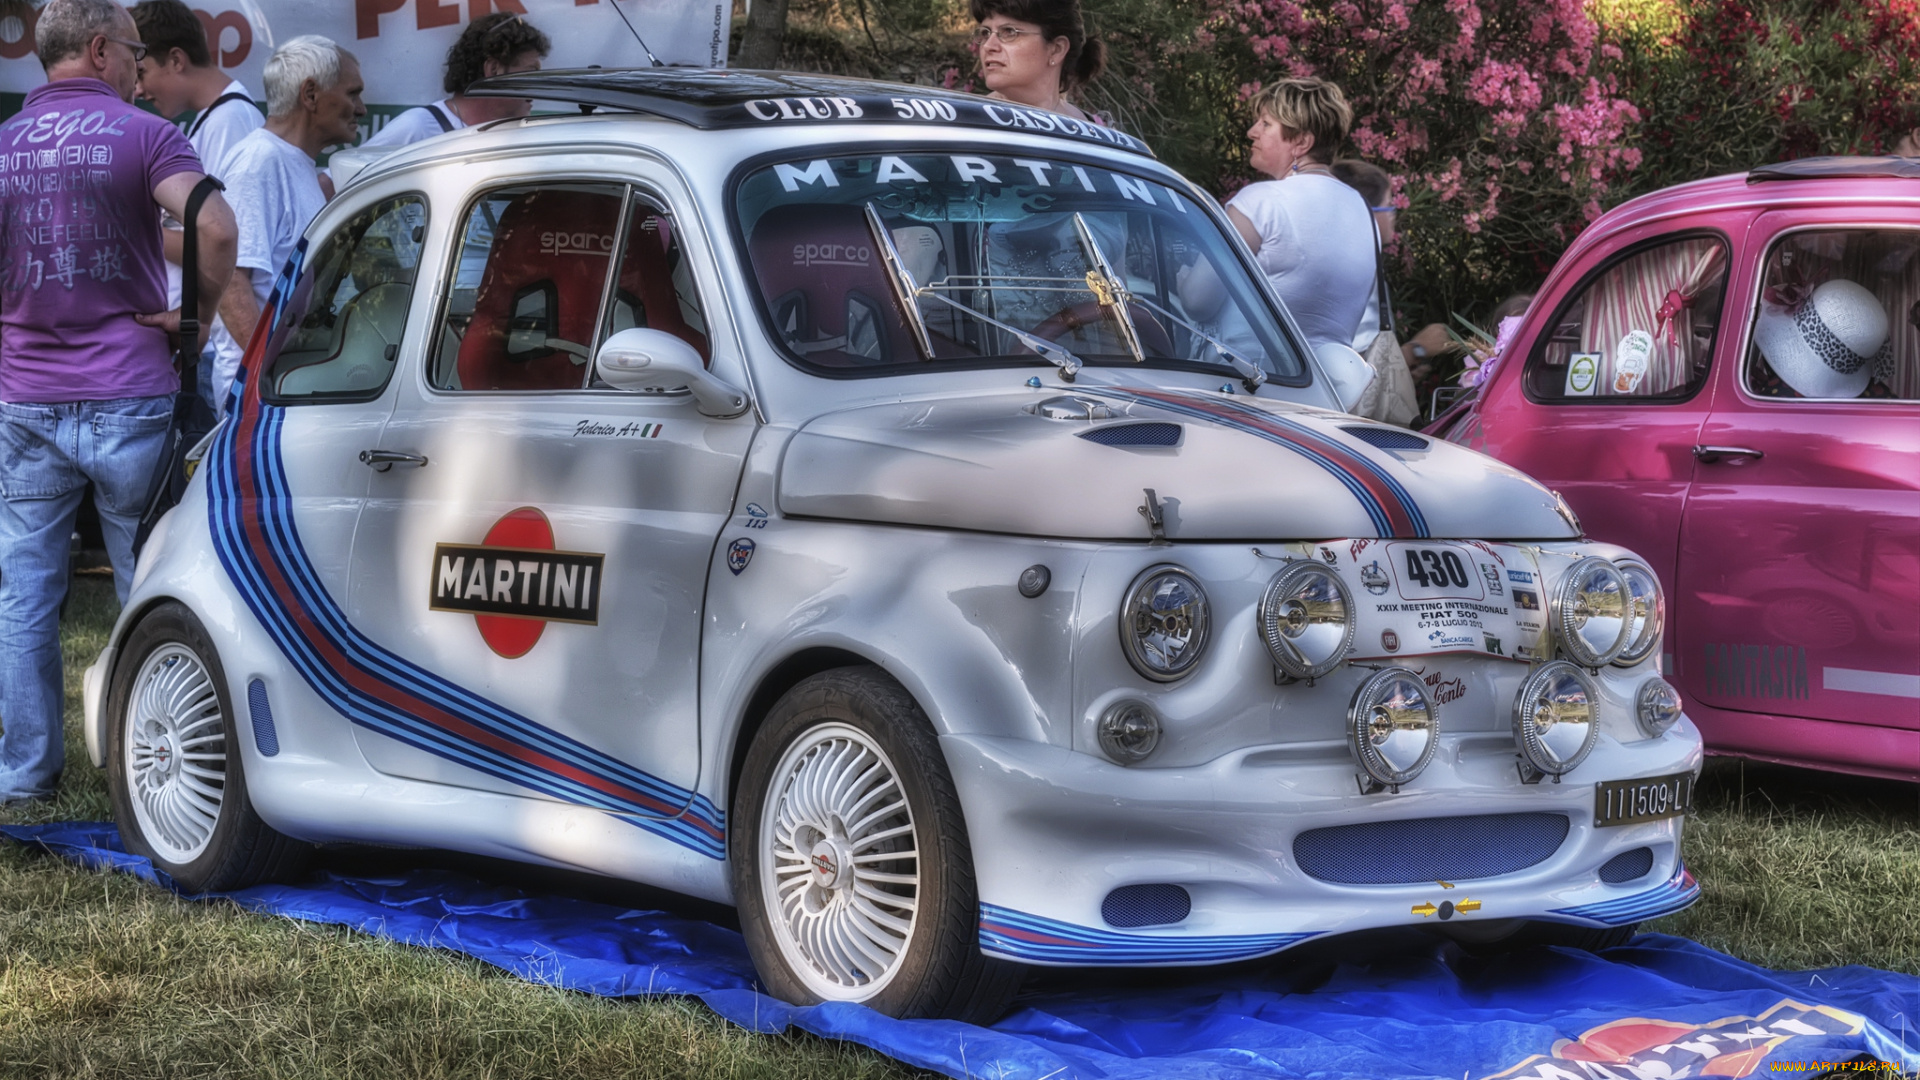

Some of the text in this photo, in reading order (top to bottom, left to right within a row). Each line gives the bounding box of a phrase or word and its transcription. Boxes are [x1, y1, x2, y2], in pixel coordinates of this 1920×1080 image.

[744, 97, 864, 121] CLUB
[892, 98, 957, 122] 500
[0, 109, 134, 147] TEGOL
[772, 156, 1187, 213] MARTINI
[541, 231, 626, 256] sparc
[793, 243, 870, 267] sparco
[573, 419, 616, 438] Federico
[745, 518, 768, 529] 113
[1404, 549, 1469, 588] 430
[437, 555, 594, 610] MARTINI
[1376, 604, 1399, 612] XXIX
[1400, 602, 1442, 611] MEETING
[1445, 602, 1509, 615] INTERNAZIONALE
[1420, 611, 1478, 619] FIAT 500
[1417, 619, 1483, 629] 6-7-8 LUGLIO 2012
[1704, 643, 1809, 701] FANTASIA
[1606, 783, 1668, 819] 111509
